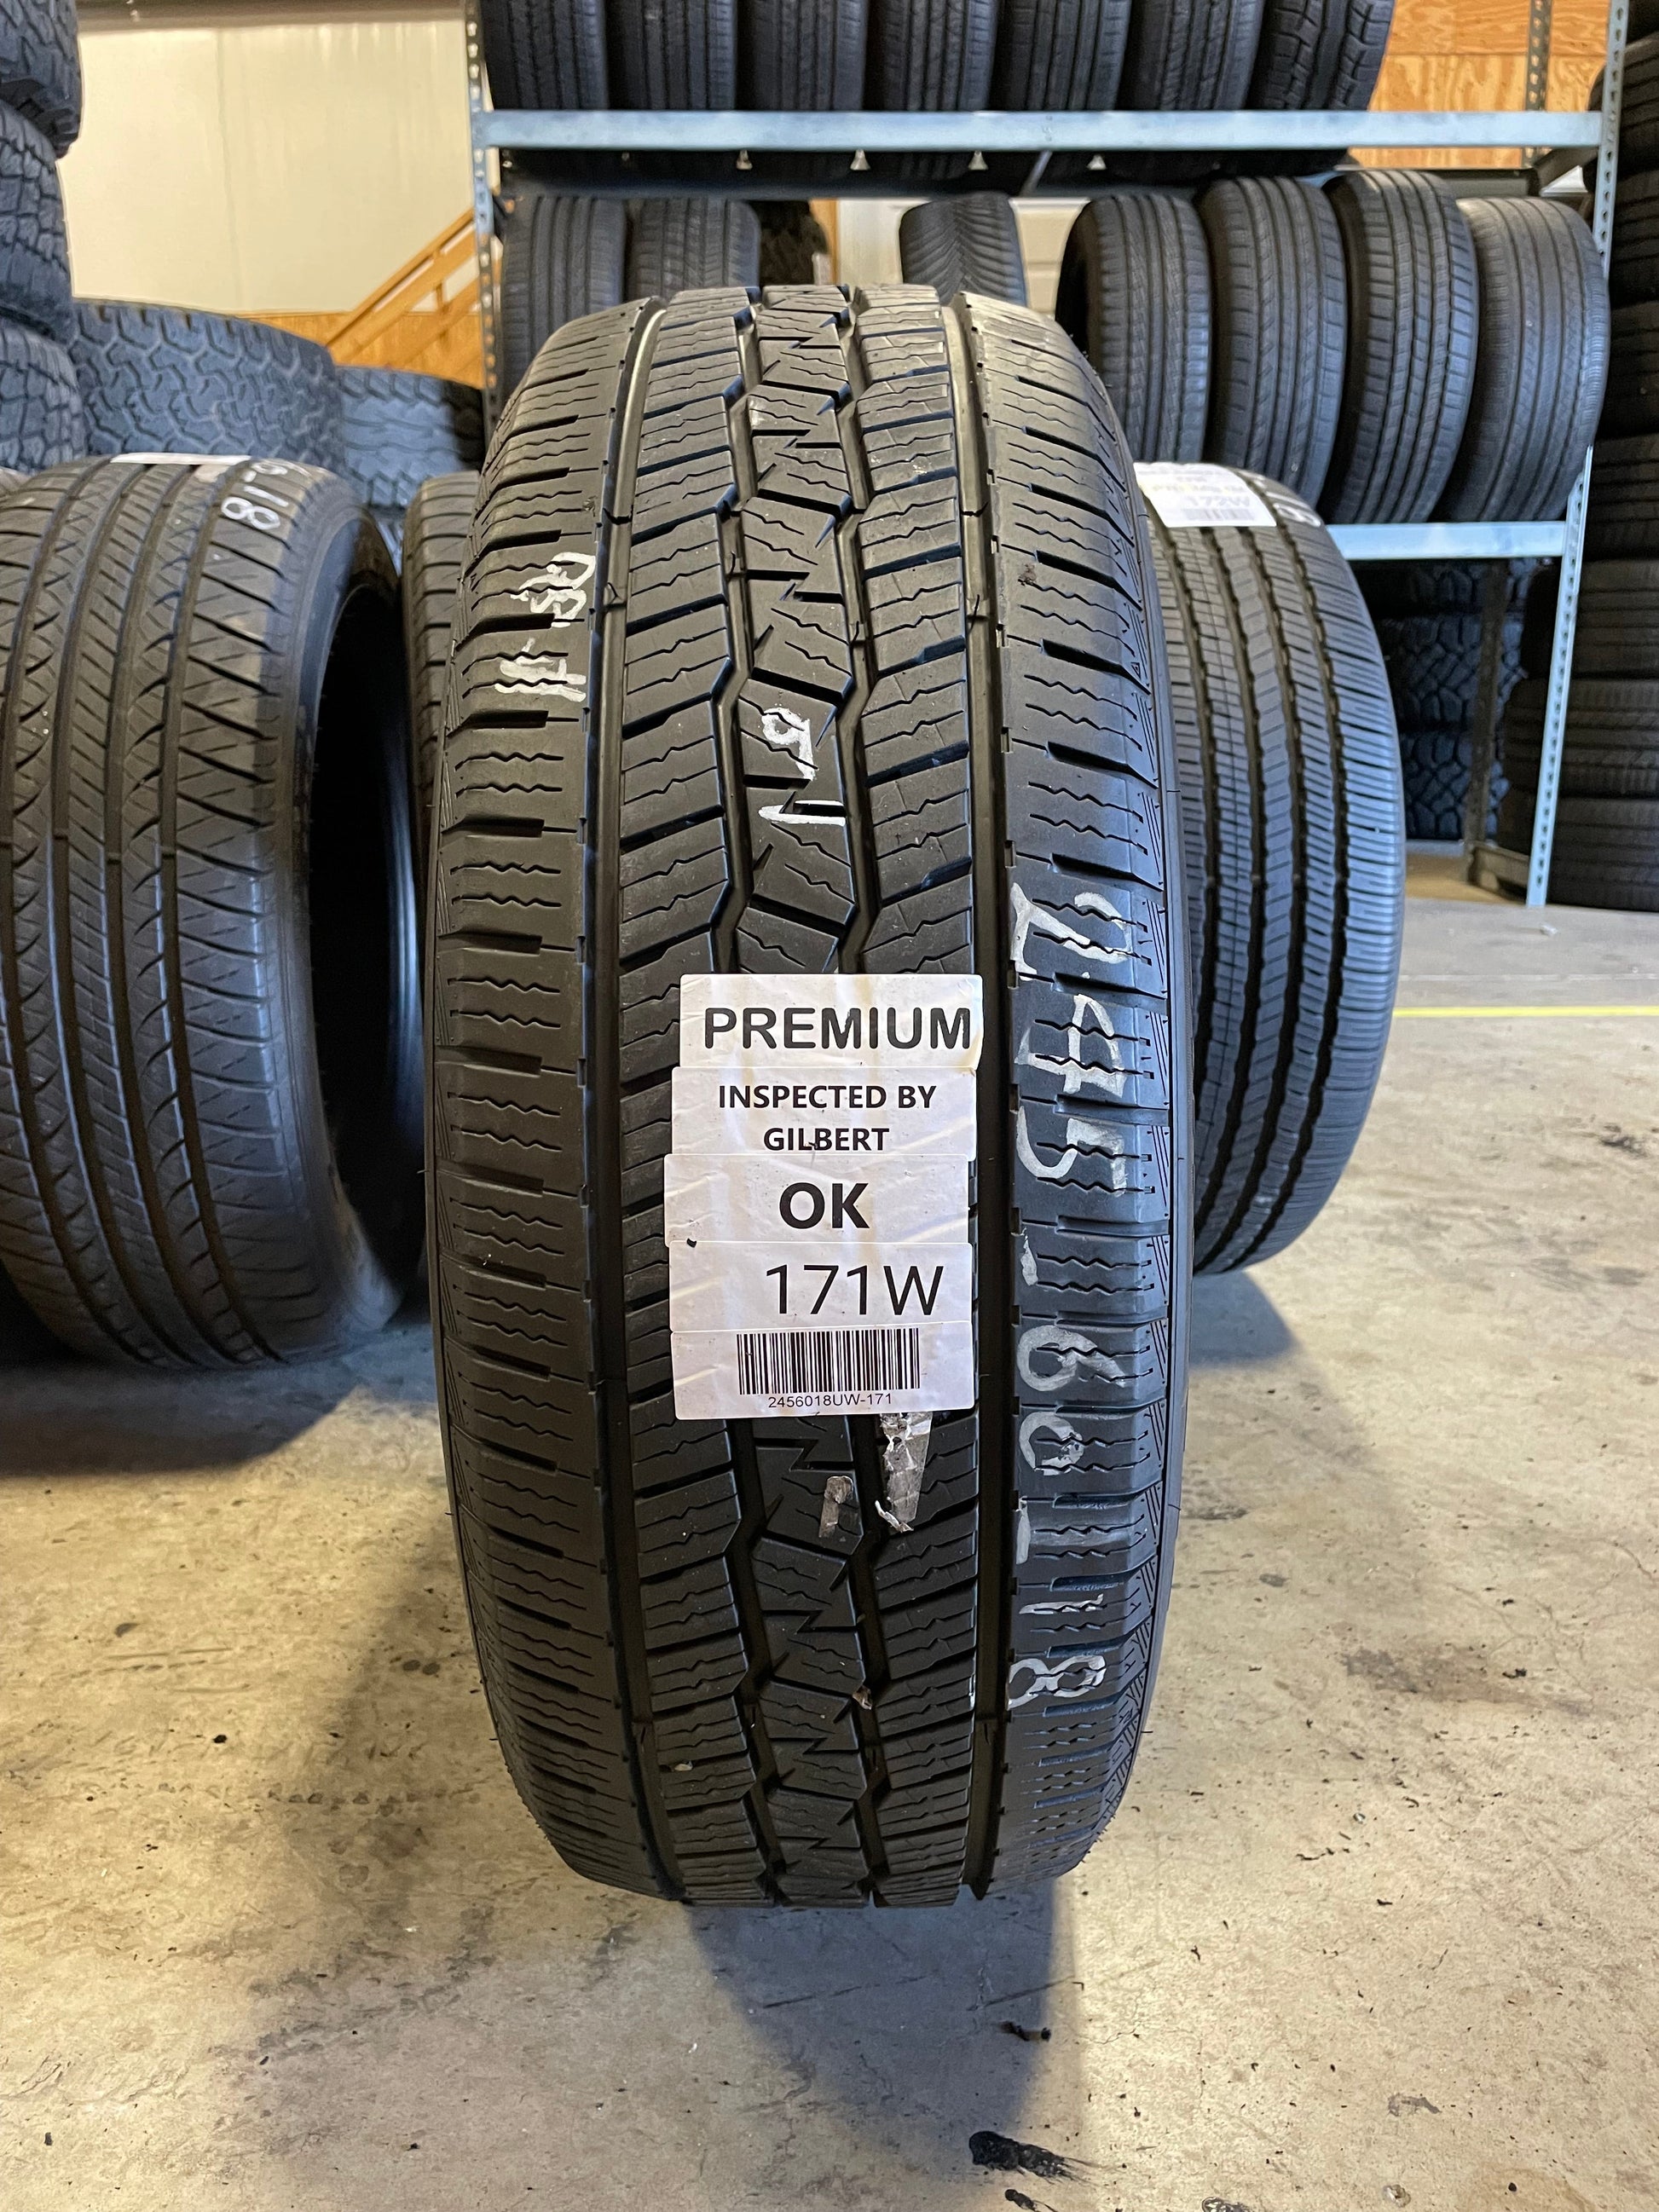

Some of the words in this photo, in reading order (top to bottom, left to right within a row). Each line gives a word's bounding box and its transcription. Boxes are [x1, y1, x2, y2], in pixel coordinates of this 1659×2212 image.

[703, 1007, 972, 1049] PREMIUM
[719, 1084, 887, 1109] INSPECTED
[898, 1084, 937, 1109] BY
[763, 1127, 889, 1152] GILBERT
[778, 1181, 870, 1230] OK
[766, 1263, 945, 1316] 171W
[767, 1393, 893, 1409] 2456018UW-171
